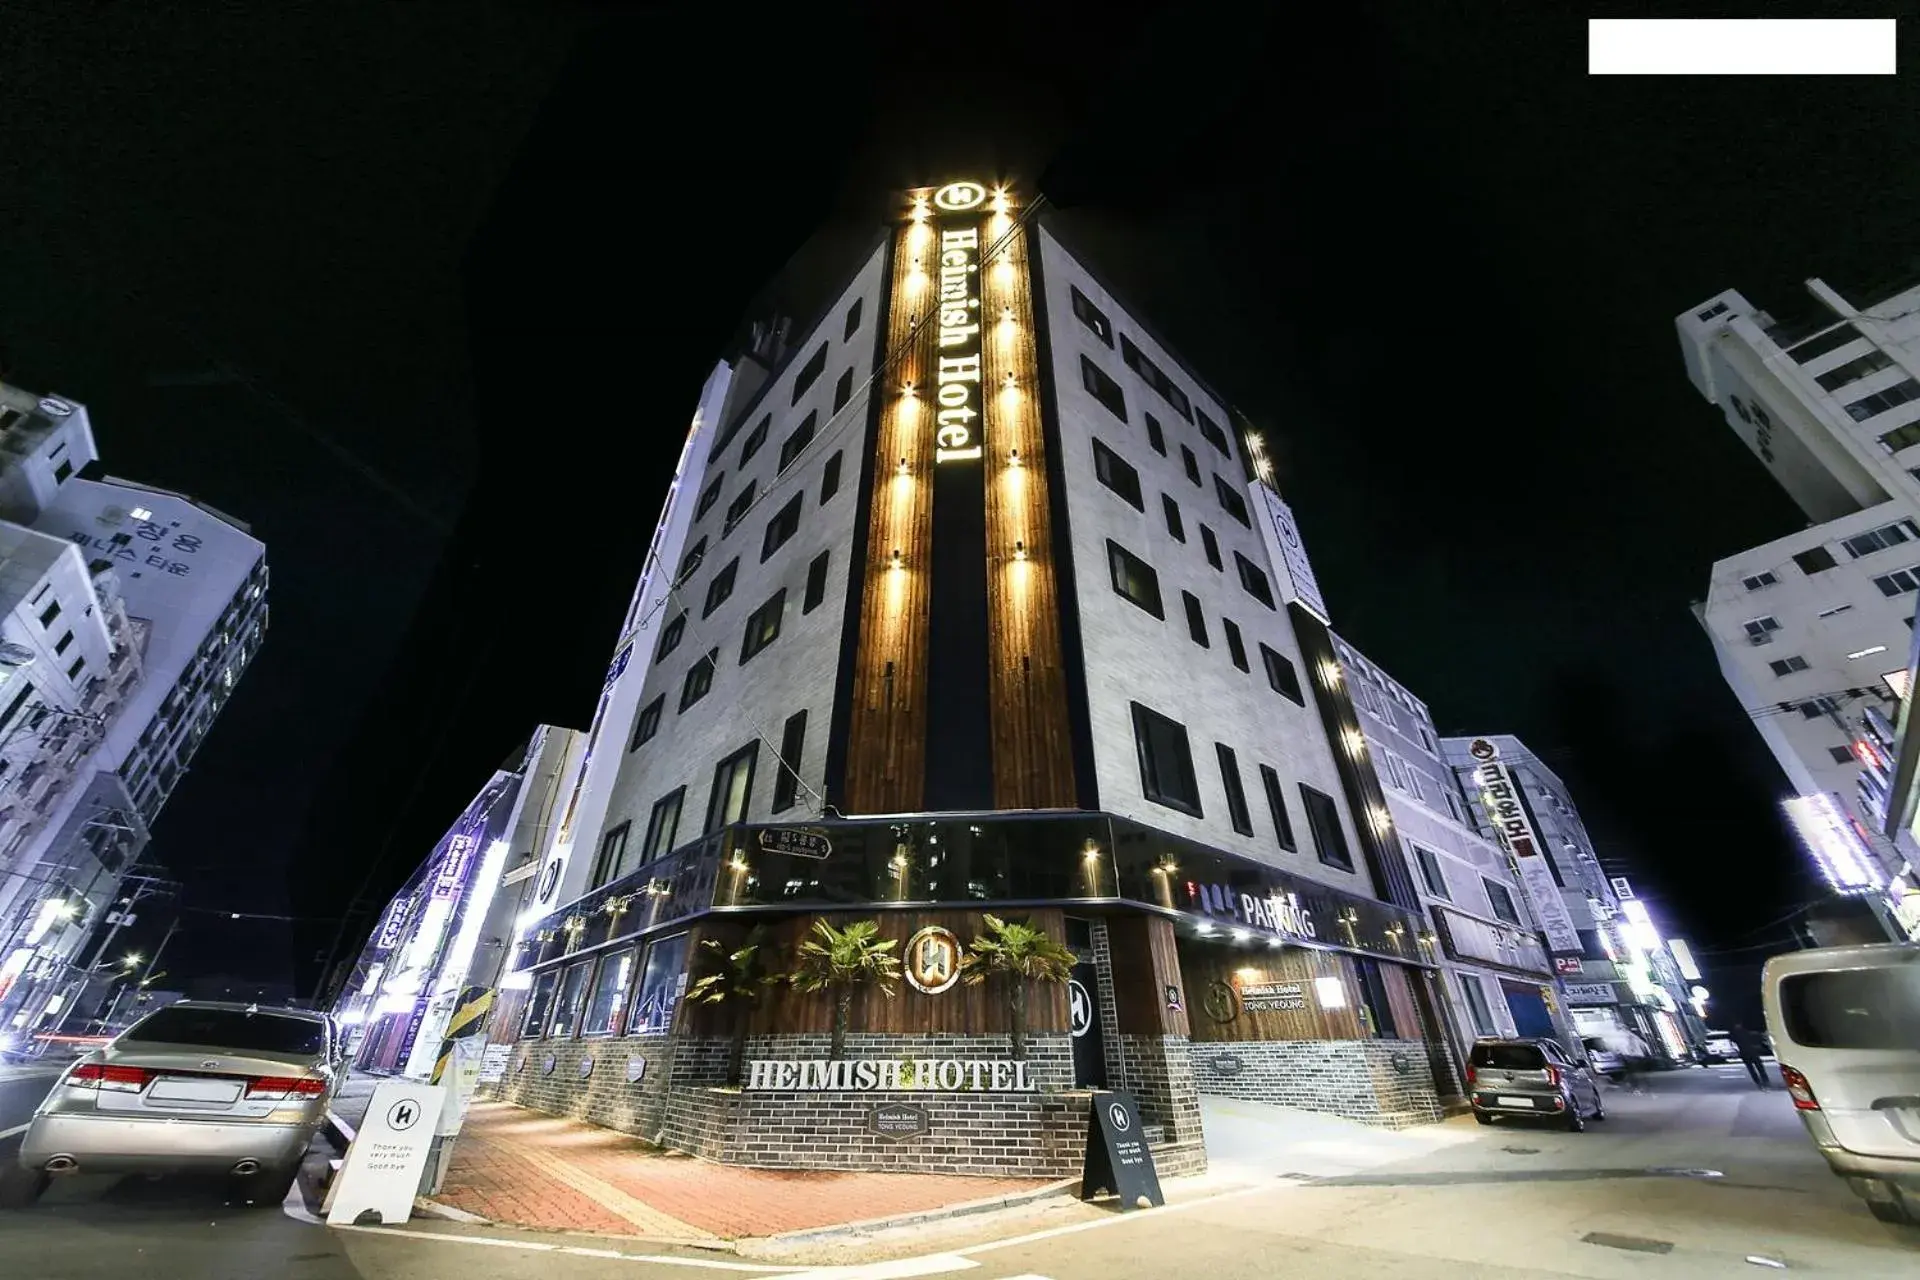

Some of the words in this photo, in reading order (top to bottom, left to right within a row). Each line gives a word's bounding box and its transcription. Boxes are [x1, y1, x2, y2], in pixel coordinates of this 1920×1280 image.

[940, 226, 980, 348] Heimish
[936, 353, 982, 464] Hotel
[744, 1060, 902, 1091] HEIMISH
[912, 1060, 1036, 1091] HOTEL
